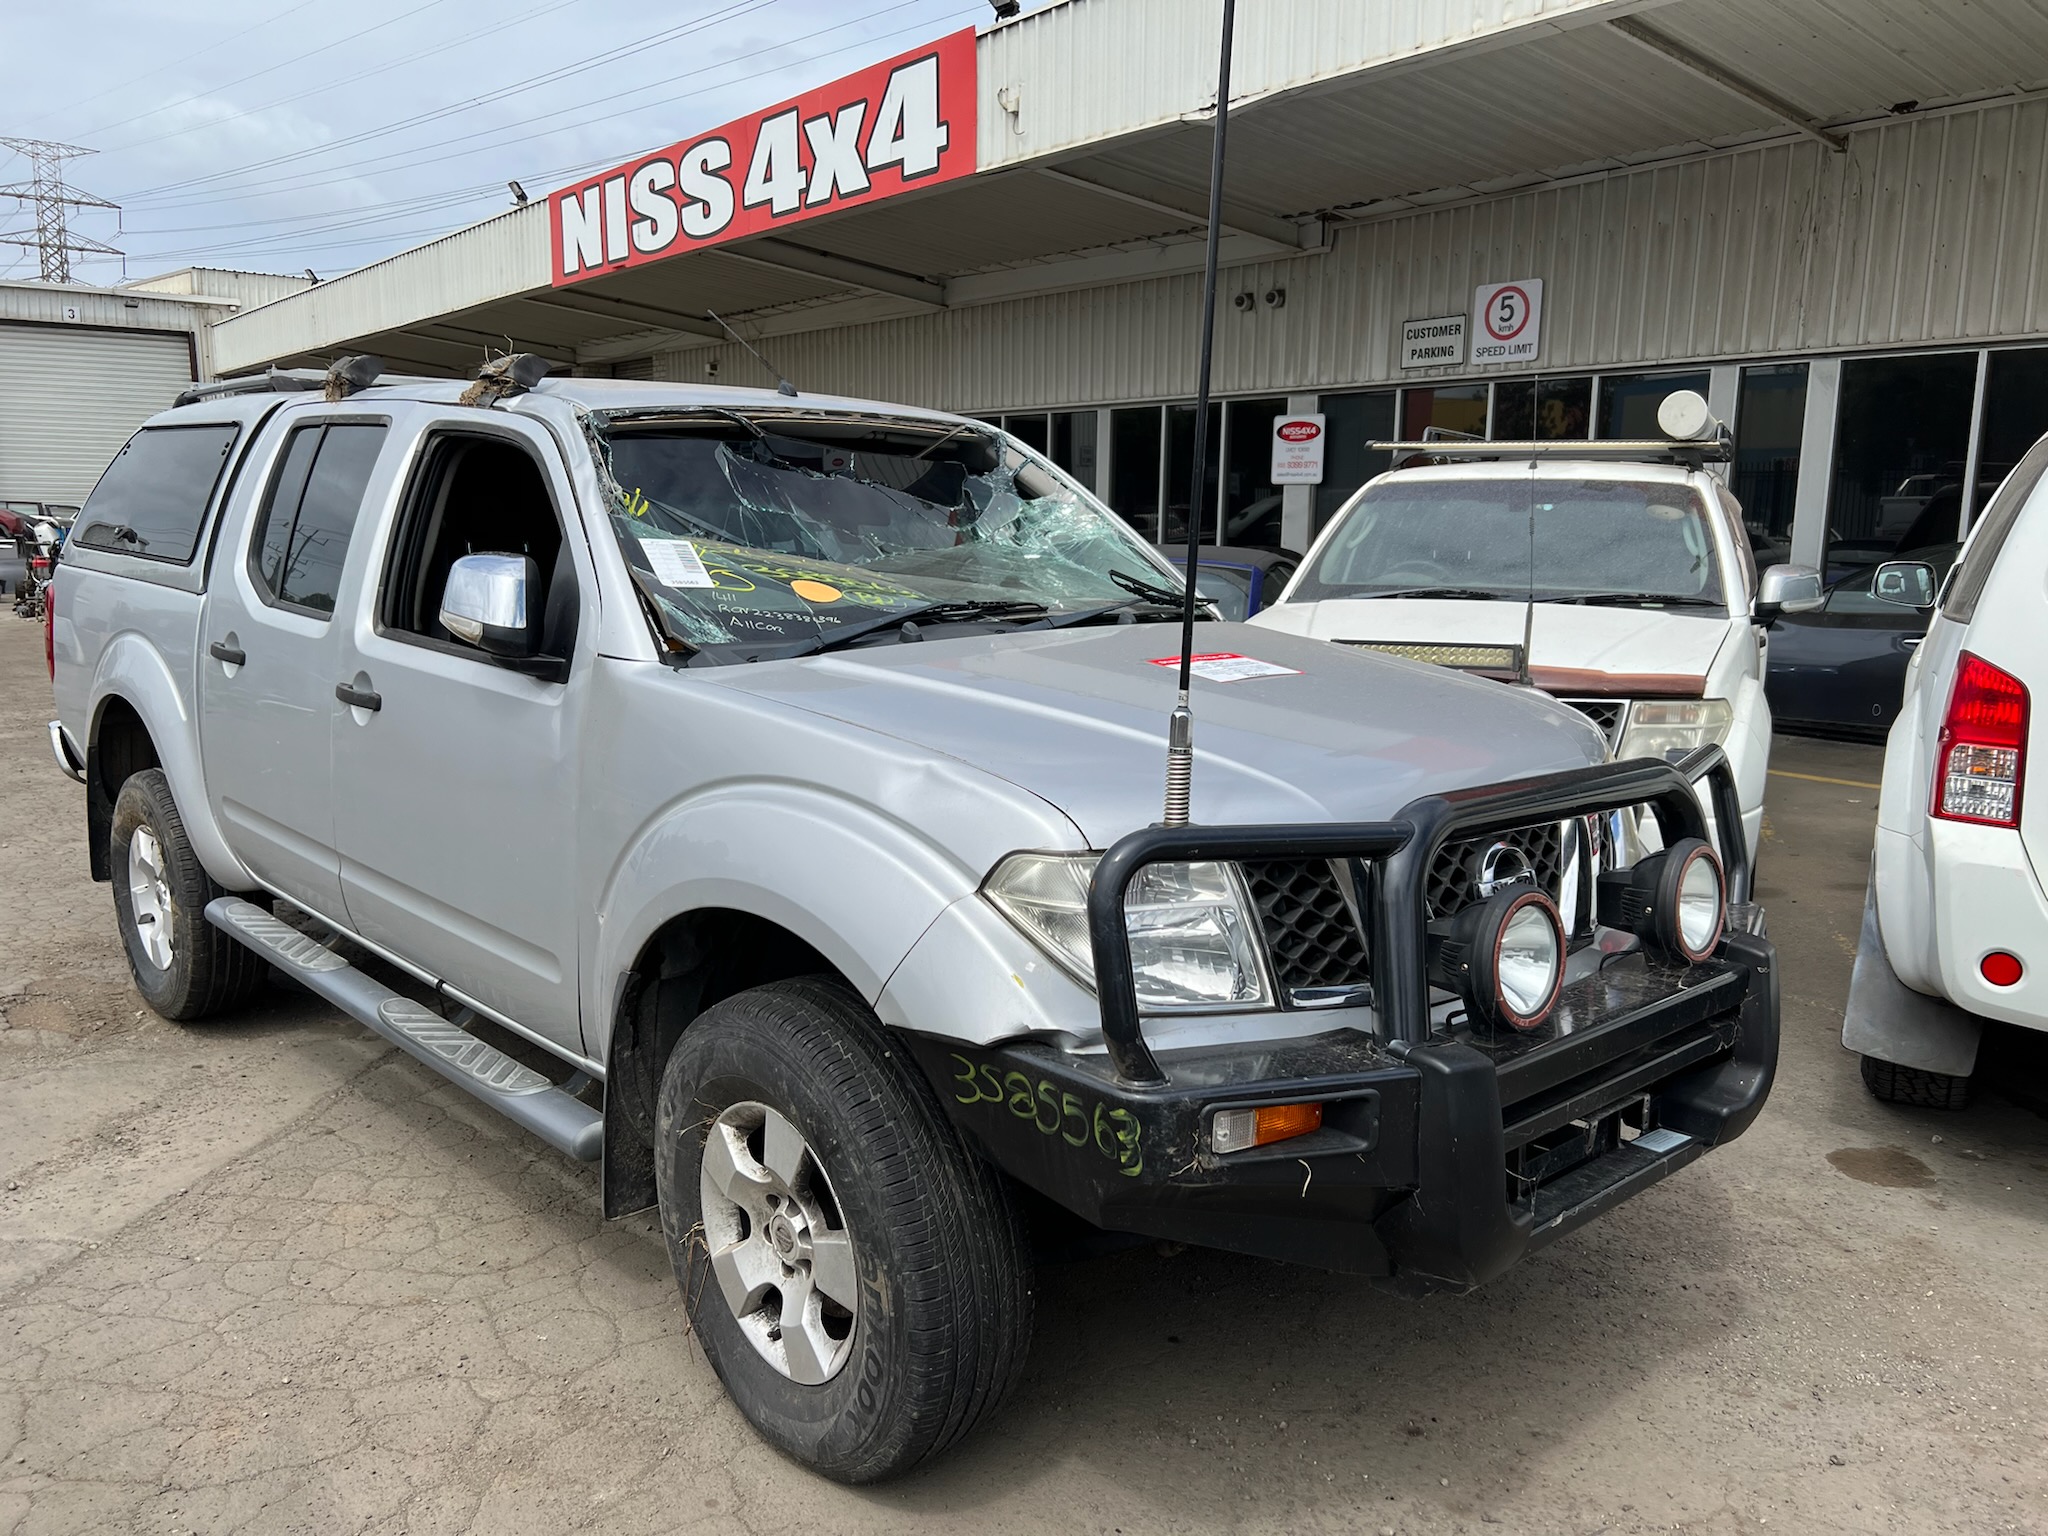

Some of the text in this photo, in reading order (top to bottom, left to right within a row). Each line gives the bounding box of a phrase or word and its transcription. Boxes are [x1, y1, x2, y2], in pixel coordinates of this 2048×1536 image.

[68, 308, 75, 319] 3
[1498, 295, 1514, 323] 5
[1406, 324, 1461, 340] CUSTOMER
[1498, 324, 1514, 333] kmh
[1411, 345, 1454, 360] PARKING
[1476, 343, 1534, 358] SPEED LIMIT
[951, 1053, 1143, 1177] 3585563
